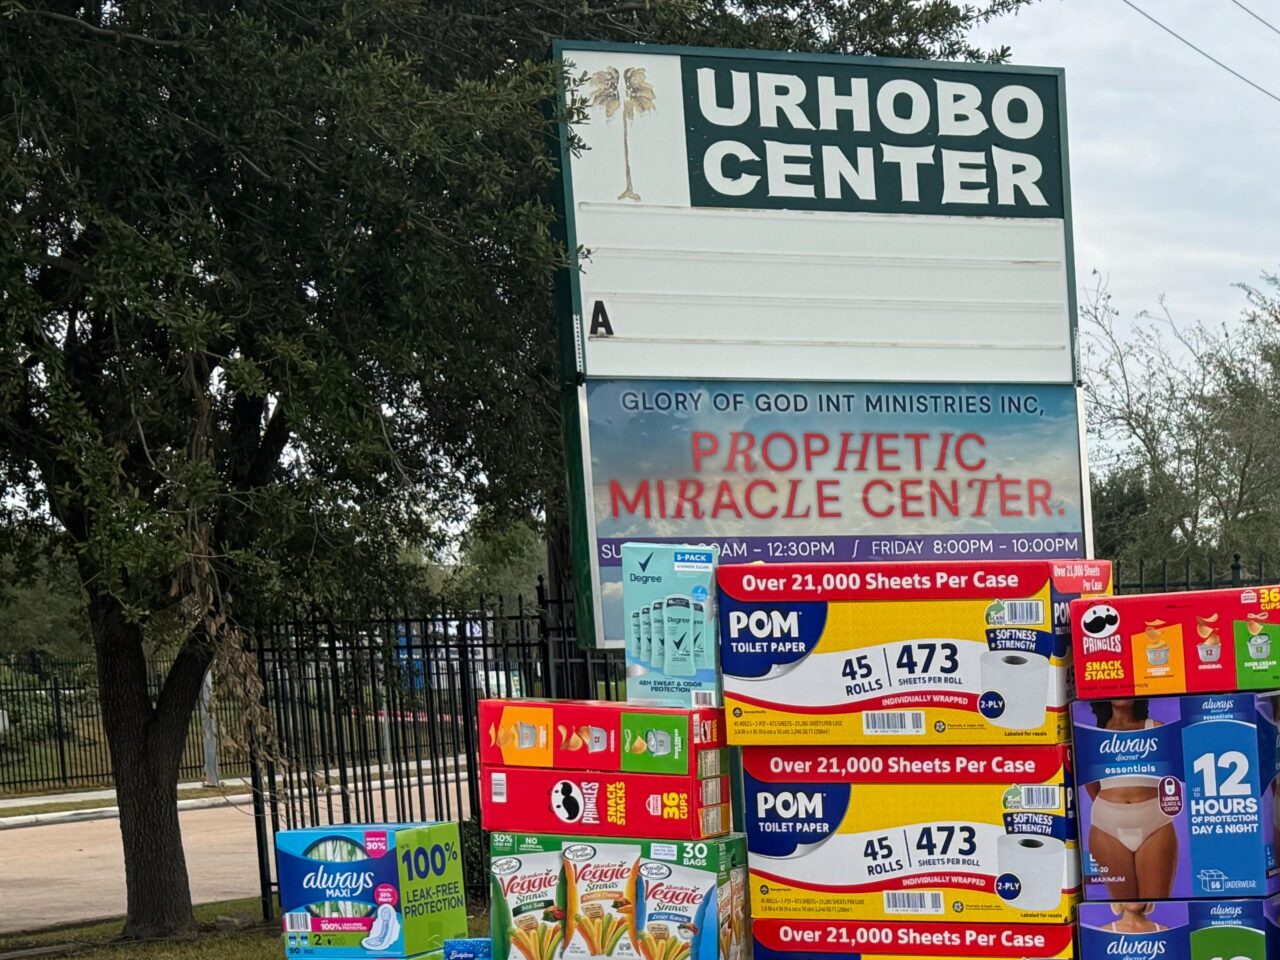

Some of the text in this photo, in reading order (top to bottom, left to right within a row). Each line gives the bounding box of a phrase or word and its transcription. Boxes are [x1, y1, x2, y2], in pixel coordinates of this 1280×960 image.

[697, 67, 1044, 138] URHOBO
[703, 139, 1049, 206] CENTER
[589, 300, 614, 336] A
[622, 392, 1044, 416] GLORY OF GOD INT MINISTRIES INC,
[690, 431, 986, 472] PROPHETIC
[609, 474, 1066, 519] MIRACLE CENTER.
[767, 538, 1078, 556] 12:30PM FRIDAY 8:00PM 10:00PM
[742, 570, 1019, 594] Over 21,000 Sheets Per Case
[1259, 588, 1280, 602] 36
[1260, 601, 1280, 611] CUPS
[729, 611, 799, 638] POM
[996, 630, 1037, 641] SOFTNESS
[997, 640, 1036, 650] STRENGTH
[1083, 634, 1121, 655] PRINGLES
[731, 642, 806, 653] TOILET PAPER
[841, 643, 959, 681] 45 473
[1086, 660, 1121, 671] SNACK
[1084, 669, 1124, 681] STACKS
[845, 676, 963, 696] ROLLS SHEETS PER ROLL
[882, 695, 969, 706] INDIVIDUALLY WRAPPED
[980, 700, 1003, 709] 2-PLY
[1099, 734, 1158, 759] always
[770, 756, 1036, 776] Over 21,000 Sheets Per Case
[1105, 764, 1156, 774] essentials
[1193, 751, 1251, 797] 12
[582, 781, 599, 824] PRINGLES
[607, 783, 616, 823] SNACK
[617, 781, 626, 826] STACKS
[756, 792, 823, 818] POM
[1191, 798, 1258, 815] HOURS
[758, 822, 829, 833] TOILET PAPER
[1192, 824, 1258, 834] DAY & NIGHT
[1204, 815, 1258, 823] PROTECTION
[683, 843, 707, 858] 30
[863, 826, 977, 861] 45 473
[402, 841, 457, 881] 100%
[683, 858, 707, 866] BAGS
[303, 865, 374, 896] always
[573, 863, 631, 884] Veggie
[326, 888, 350, 898] MAXI
[406, 881, 459, 904] LEAK-FREE
[644, 880, 703, 905] Veggie
[404, 895, 464, 919] PROTECTION
[779, 926, 1045, 947] Over 21,000 Sheets Per Case
